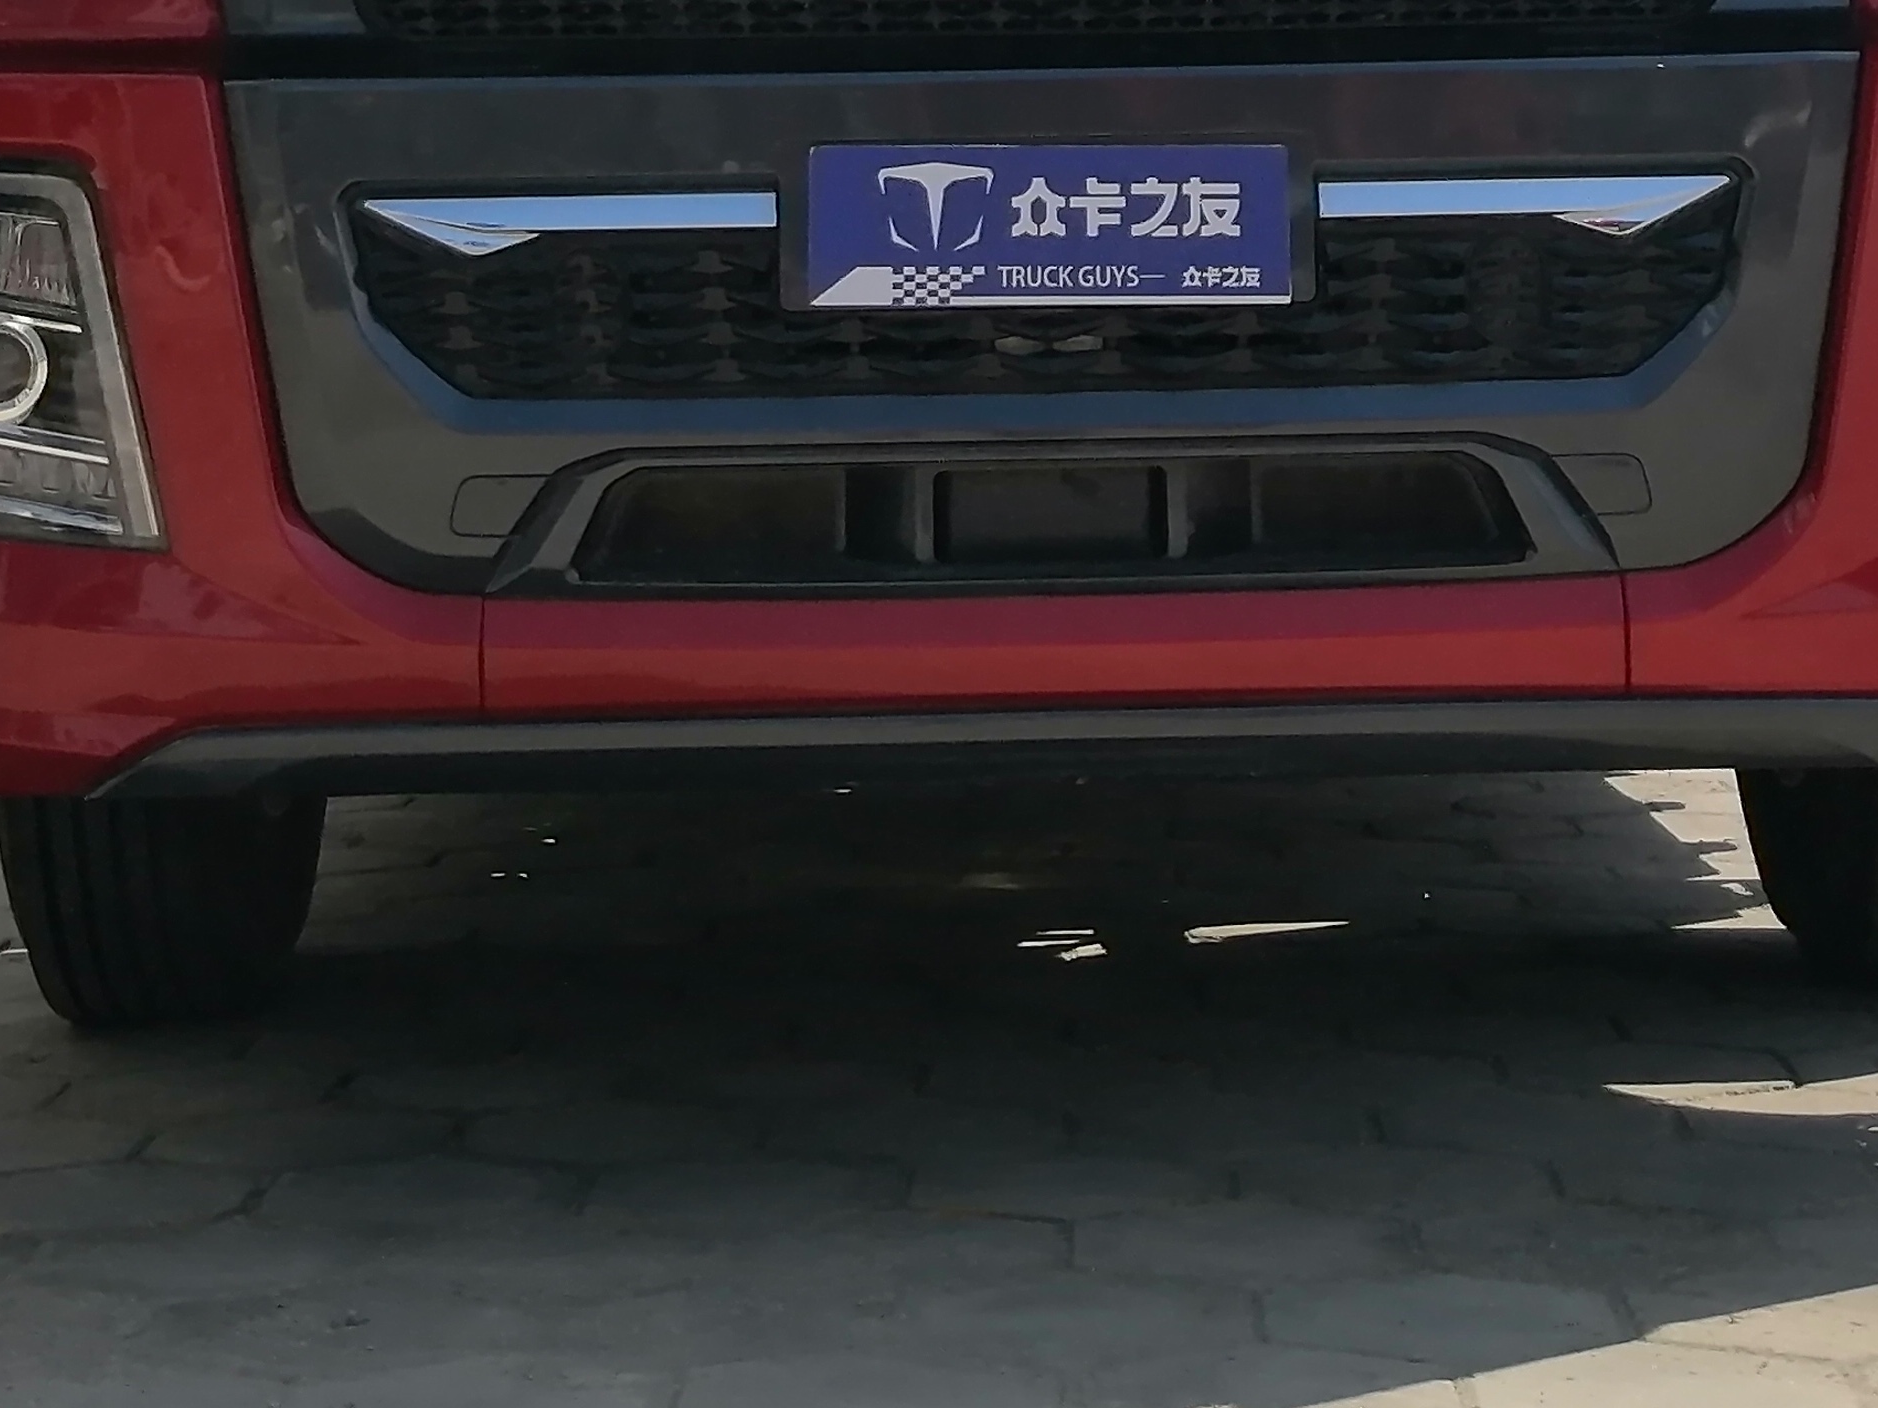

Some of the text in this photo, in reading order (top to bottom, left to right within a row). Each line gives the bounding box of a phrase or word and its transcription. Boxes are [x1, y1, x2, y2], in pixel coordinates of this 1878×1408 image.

[1010, 175, 1242, 239] 众卡之友
[997, 265, 1074, 289] TRUCK
[1180, 265, 1261, 289] 众卡之友
